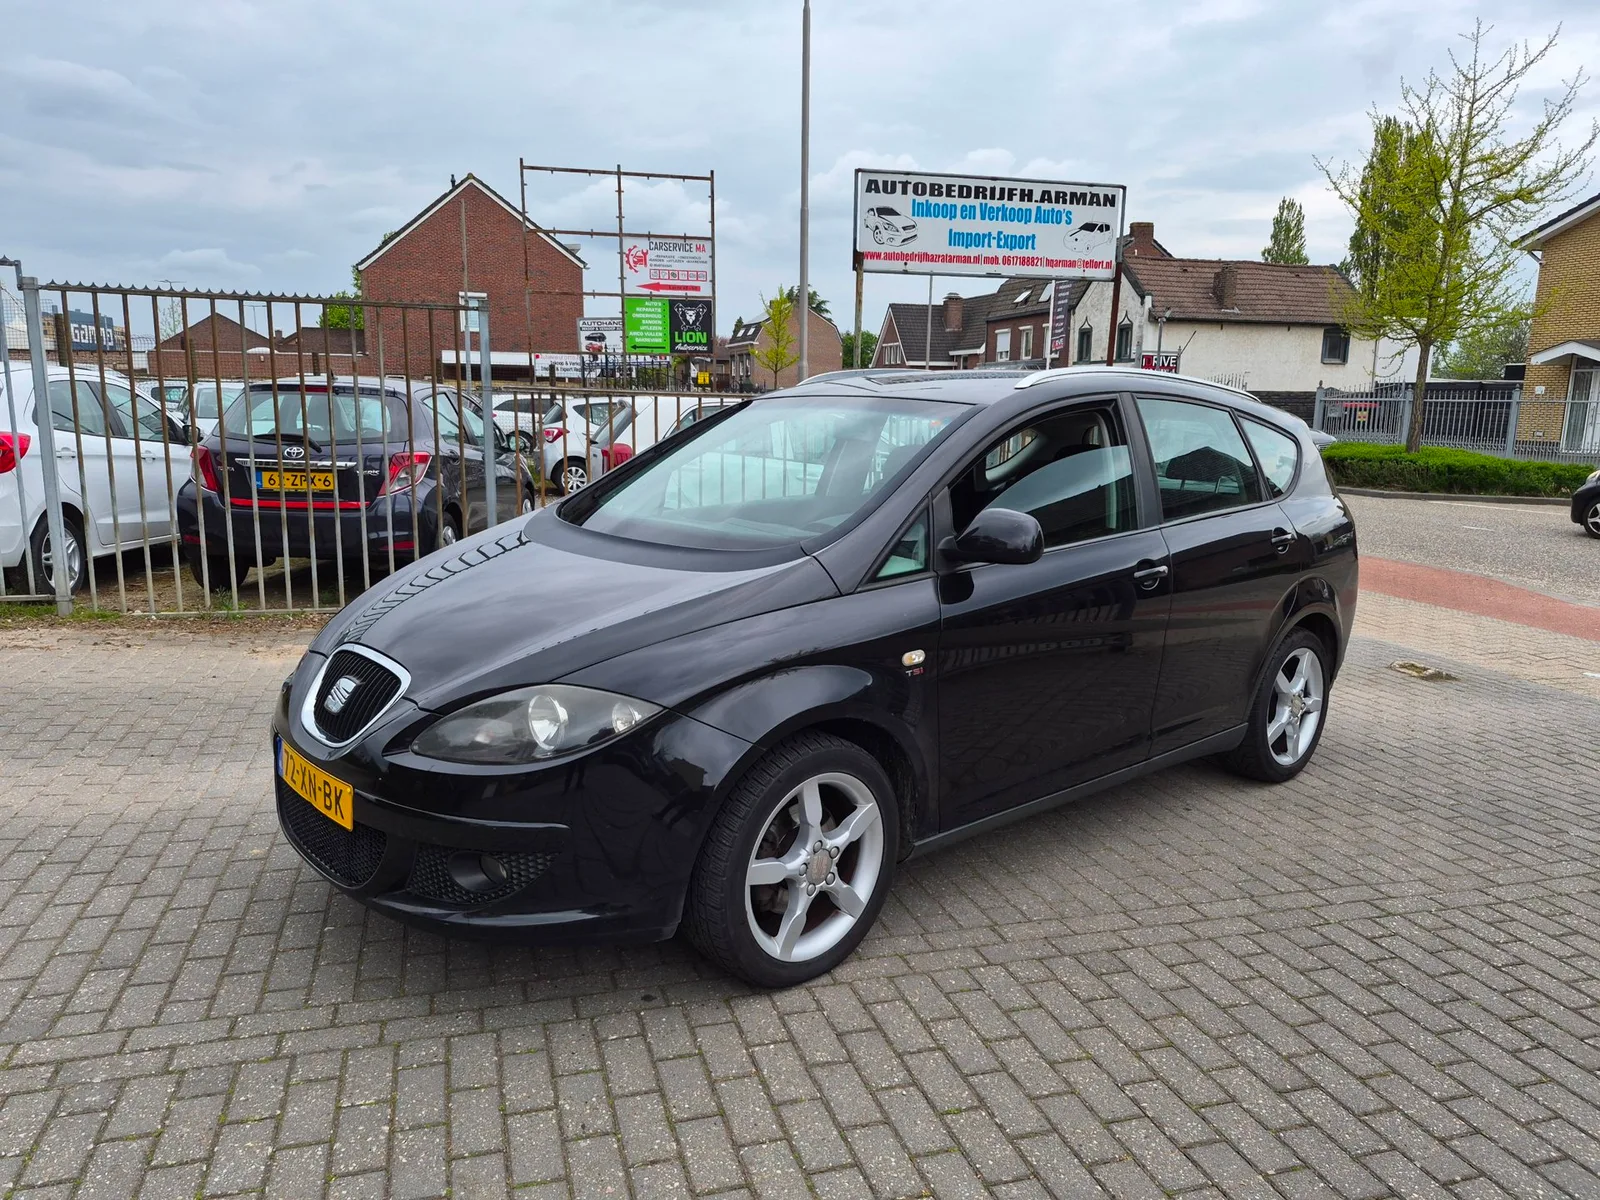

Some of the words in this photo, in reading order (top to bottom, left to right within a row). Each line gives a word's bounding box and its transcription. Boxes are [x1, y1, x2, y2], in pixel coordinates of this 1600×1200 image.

[911, 198, 958, 221] Inkoop
[960, 203, 977, 220] en
[979, 202, 1032, 225] Verkoop
[1034, 205, 1073, 226] Auto's
[948, 228, 1036, 251] Import-Export
[648, 241, 694, 253] CARSERVICE
[695, 243, 707, 254] MA
[1002, 255, 1043, 267] 0617188821
[674, 331, 707, 343] LION
[674, 343, 708, 351] Autoservice
[284, 748, 345, 820] 72-XN-BK
